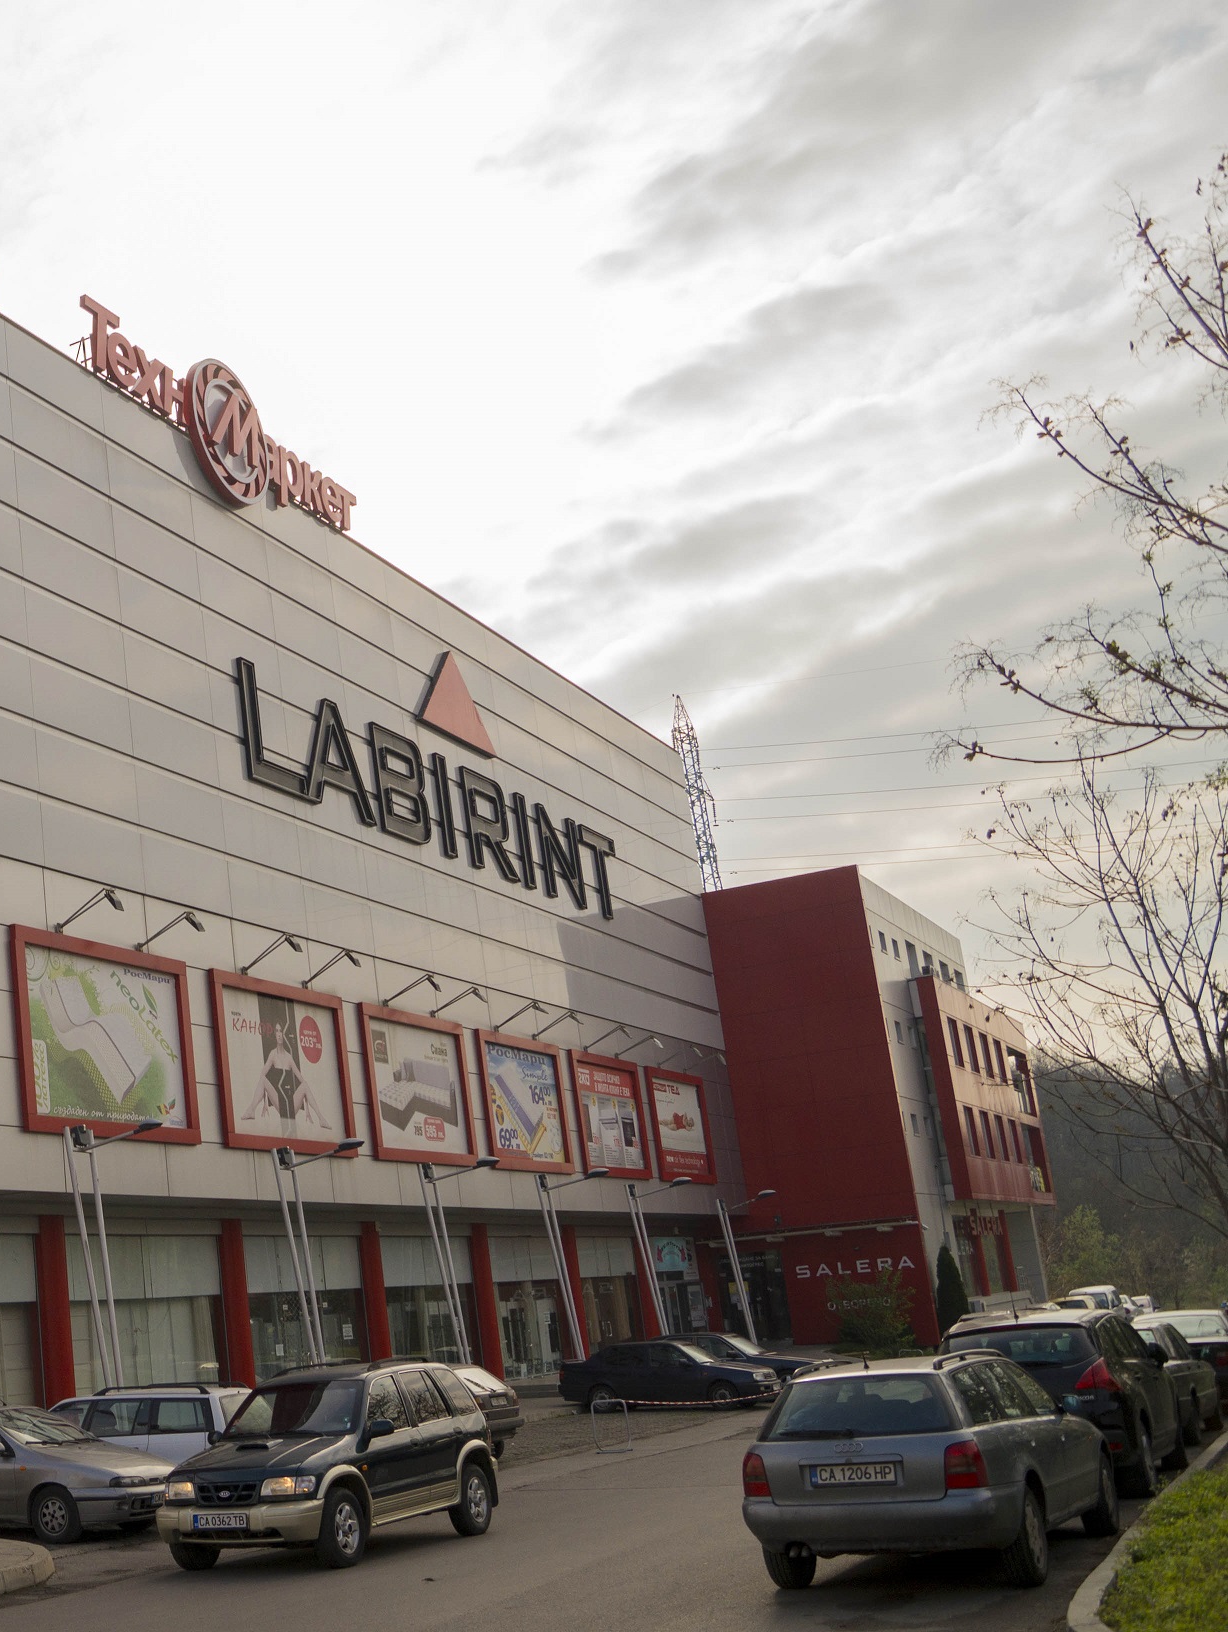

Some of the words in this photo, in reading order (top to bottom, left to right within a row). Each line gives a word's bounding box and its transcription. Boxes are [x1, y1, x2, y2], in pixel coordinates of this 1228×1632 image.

[236, 656, 615, 920] LABIRINT
[123, 967, 171, 985] РосМари
[486, 1043, 547, 1067] РосМари
[521, 1066, 549, 1083] Simple
[53, 1104, 89, 1116] създаден
[795, 1255, 916, 1279] SALERA
[840, 1466, 872, 1480] 1206
[874, 1465, 892, 1479] HP
[199, 1516, 210, 1527] CA
[211, 1516, 232, 1527] 0362
[234, 1515, 245, 1526] TB
